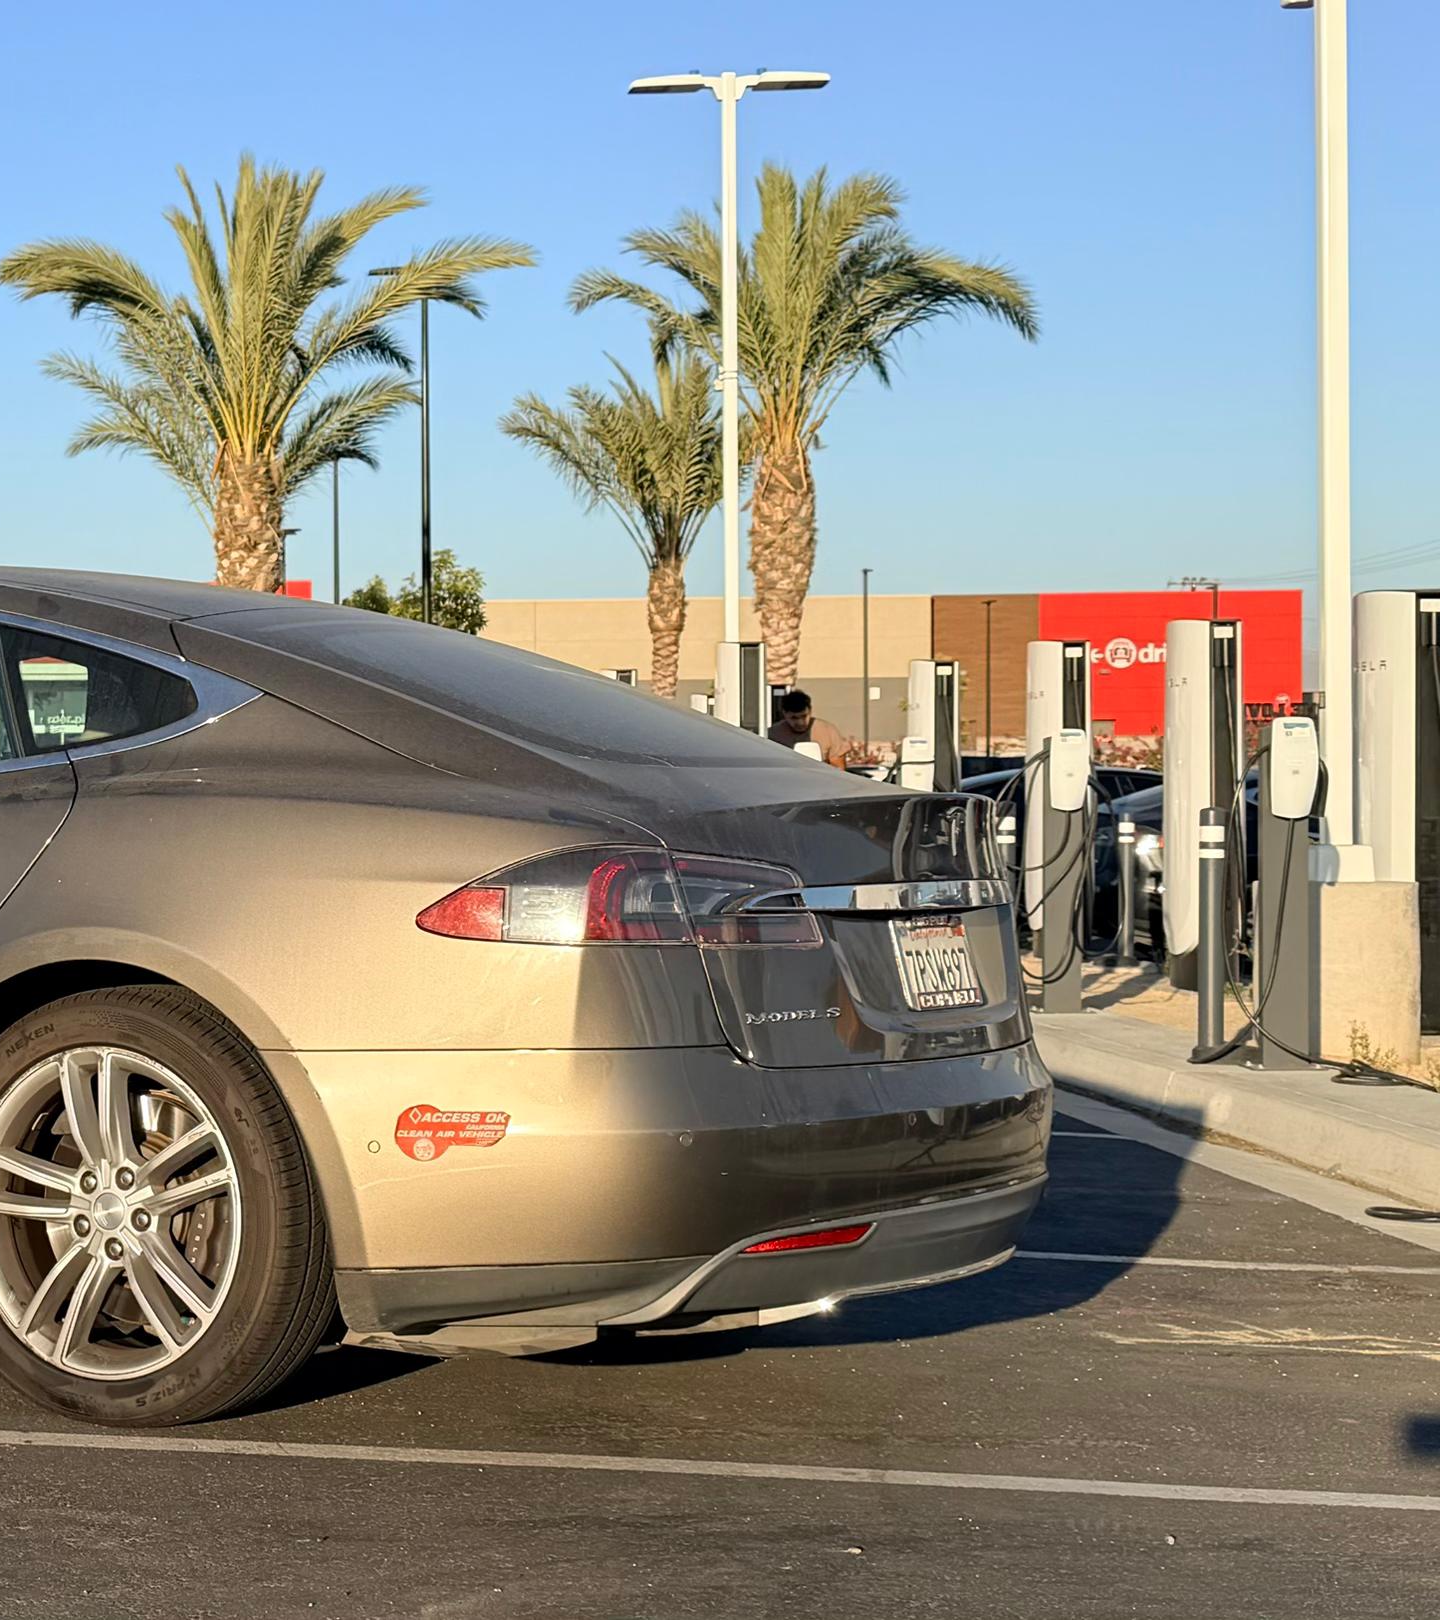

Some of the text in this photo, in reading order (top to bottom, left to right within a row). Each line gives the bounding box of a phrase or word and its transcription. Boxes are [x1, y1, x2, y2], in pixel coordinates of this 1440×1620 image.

[745, 1007, 841, 1025] MODEL S
[5, 1024, 54, 1058] NEXEN
[421, 1112, 508, 1123] ACCESS OK
[396, 1130, 505, 1138] CLEAN AIR VEHICLE
